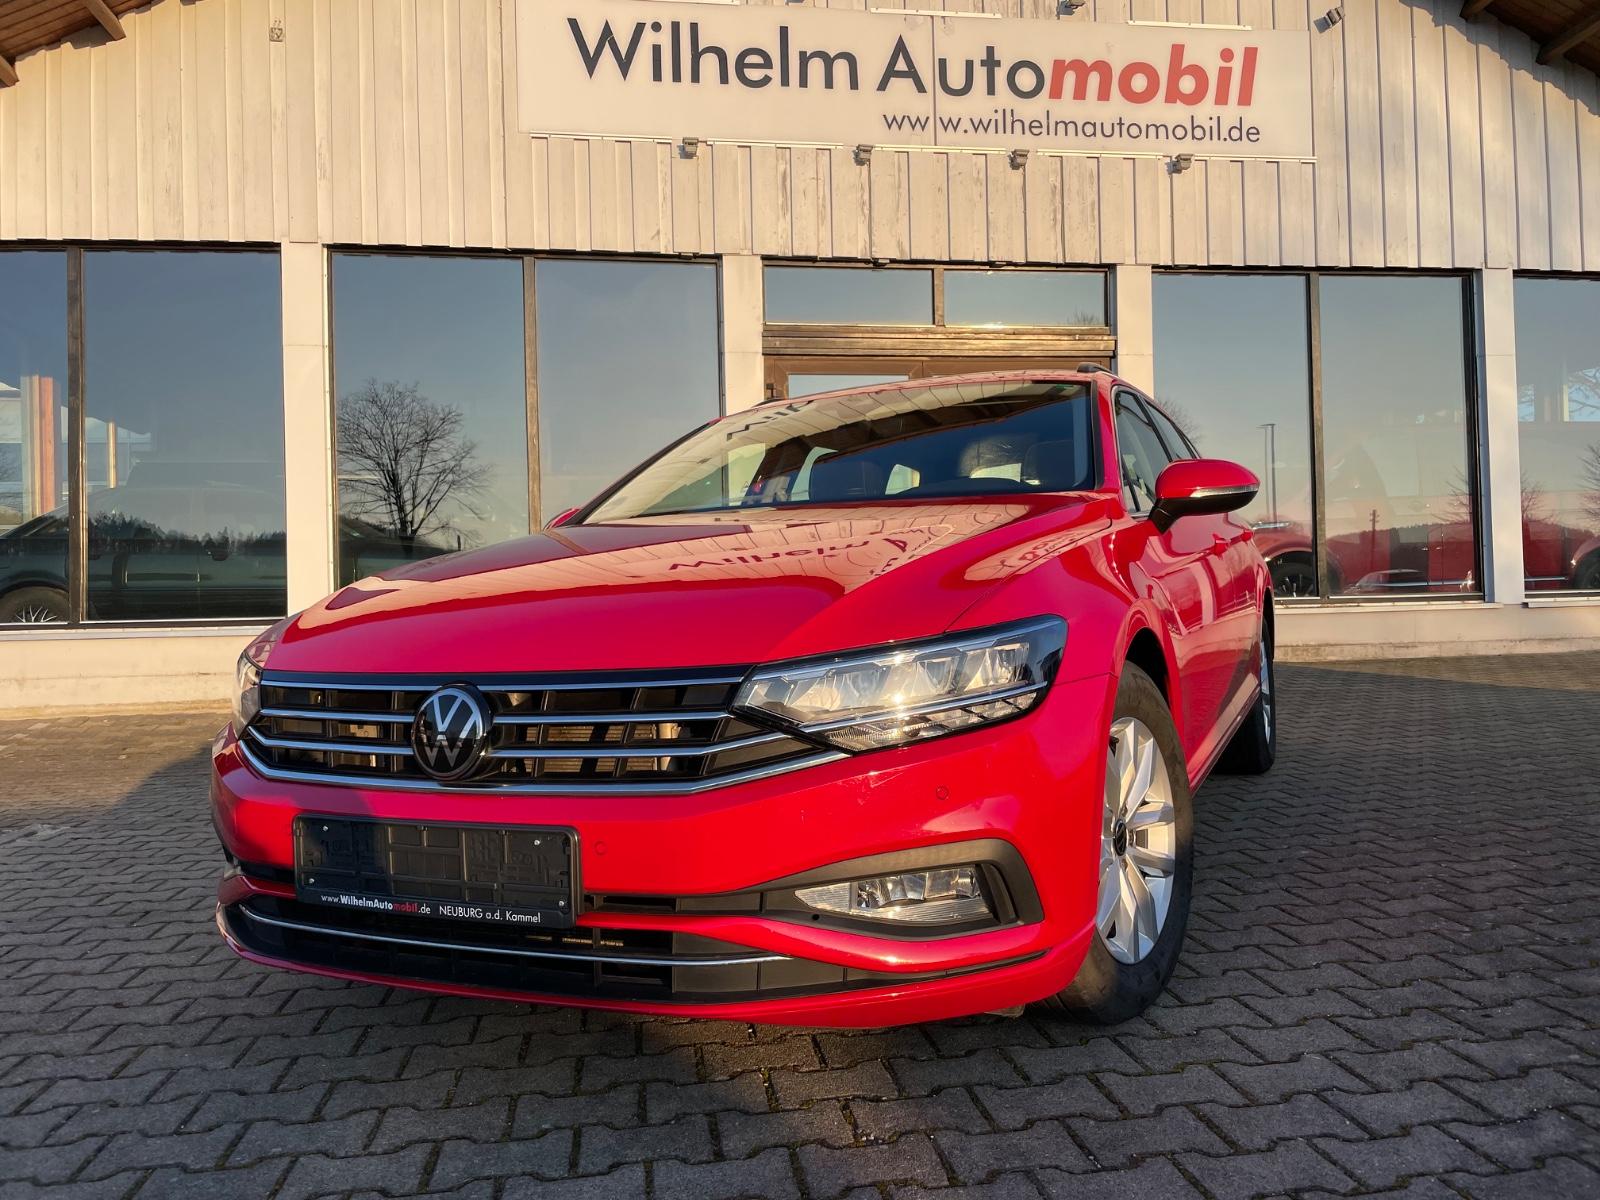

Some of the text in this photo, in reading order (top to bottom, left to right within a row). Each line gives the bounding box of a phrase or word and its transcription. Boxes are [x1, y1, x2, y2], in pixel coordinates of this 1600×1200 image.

[567, 17, 1258, 106] Wilhelm Automobil
[883, 108, 1261, 143] www.wilhelmautomobil.de
[439, 905, 484, 919] NEUBURG
[485, 909, 503, 920] a.d.
[505, 910, 541, 923] Kammel
